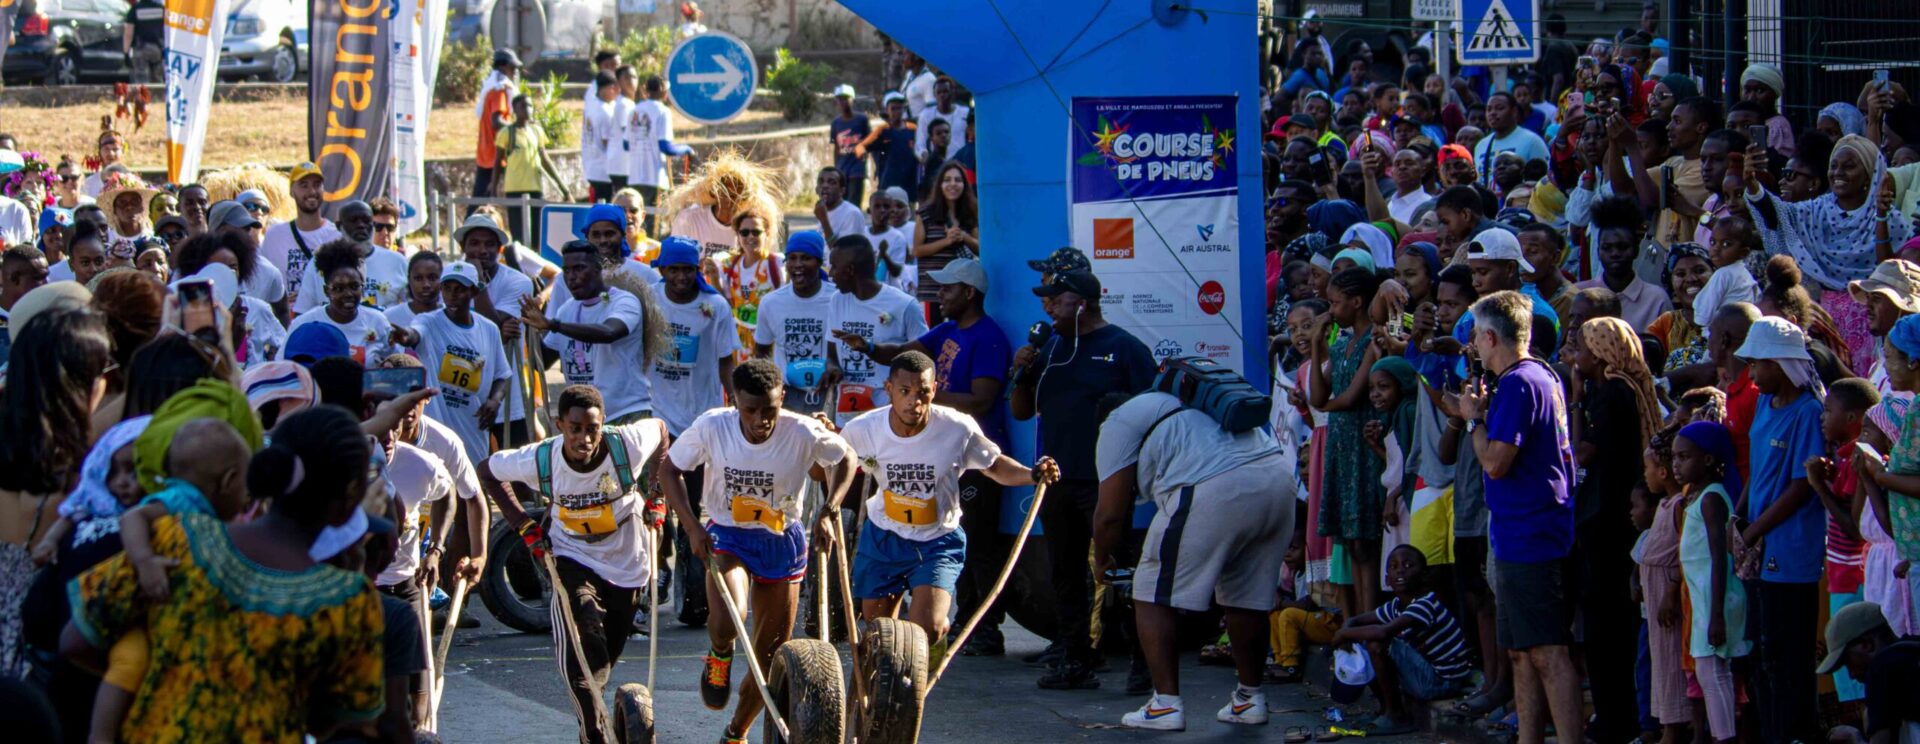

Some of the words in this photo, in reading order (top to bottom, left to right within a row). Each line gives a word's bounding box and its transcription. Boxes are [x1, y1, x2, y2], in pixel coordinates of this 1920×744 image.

[1113, 132, 1214, 158] COURSE
[1117, 162, 1142, 181] DE
[1147, 160, 1214, 181] PNEUS
[1095, 248, 1130, 258] orange
[1180, 245, 1194, 253] AIR
[1196, 243, 1231, 253] AUSTRAL
[784, 324, 822, 333] PNEUS
[785, 334, 822, 346] MAY
[1155, 348, 1182, 357] ADEP
[453, 370, 470, 388] 16
[804, 372, 814, 386] 9
[849, 396, 858, 412] 2
[724, 466, 764, 477] COURSE
[886, 463, 925, 471] COURSE
[724, 472, 773, 487] PNEUS
[886, 470, 935, 481] PNEUS
[726, 481, 772, 498] MAY
[889, 481, 935, 493] MAY
[560, 491, 600, 501] COURSE
[753, 509, 763, 521] 1
[904, 509, 913, 523] 1
[582, 521, 593, 534] 1
